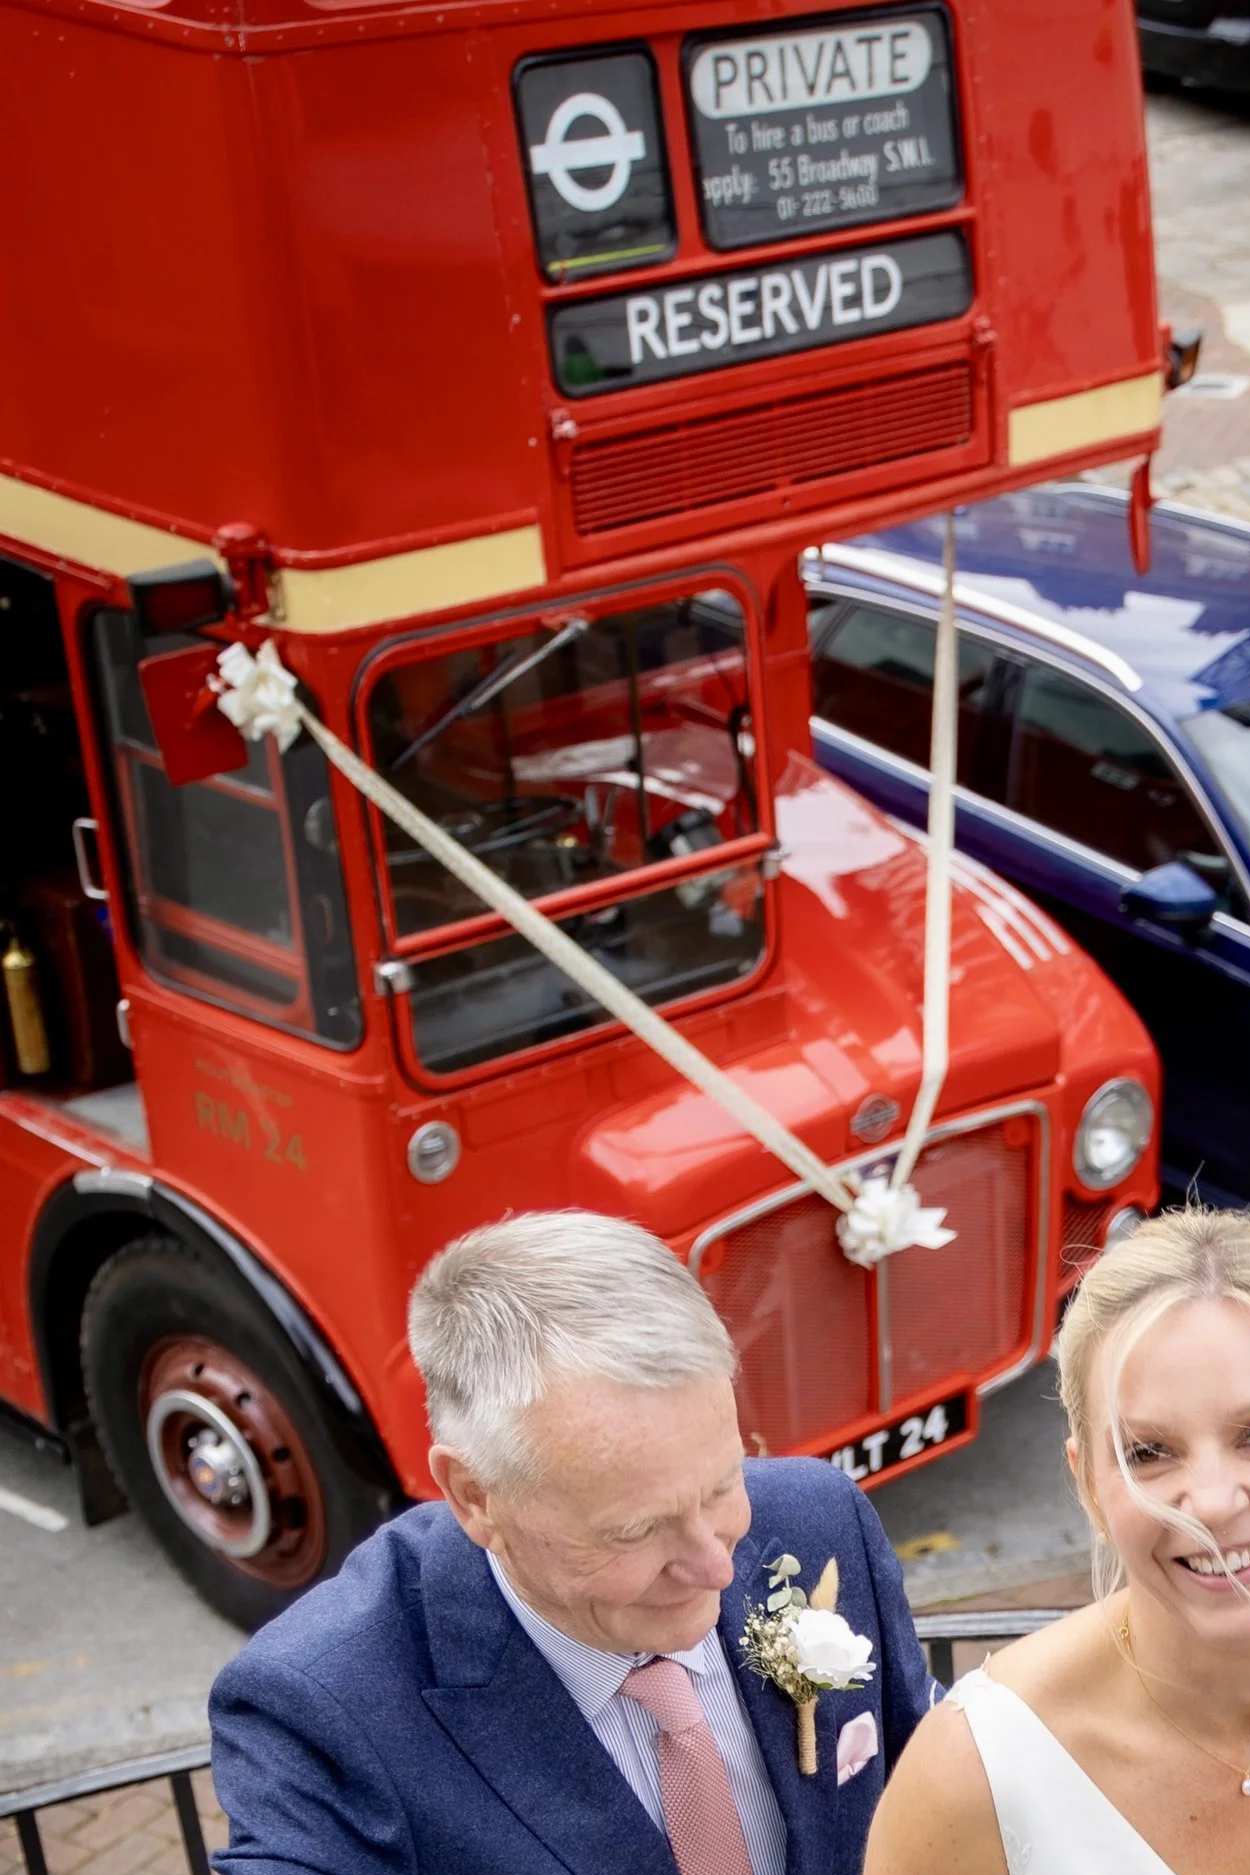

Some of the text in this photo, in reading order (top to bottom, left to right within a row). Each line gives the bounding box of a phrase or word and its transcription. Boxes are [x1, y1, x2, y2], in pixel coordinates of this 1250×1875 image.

[711, 30, 910, 110] PRIVATE
[725, 98, 910, 154] To hire a bus or coach
[768, 155, 795, 191] 55
[797, 147, 879, 187] Broadway
[626, 253, 902, 364] RESERVED
[195, 1091, 307, 1169] RM 24
[899, 1404, 949, 1460] 24
